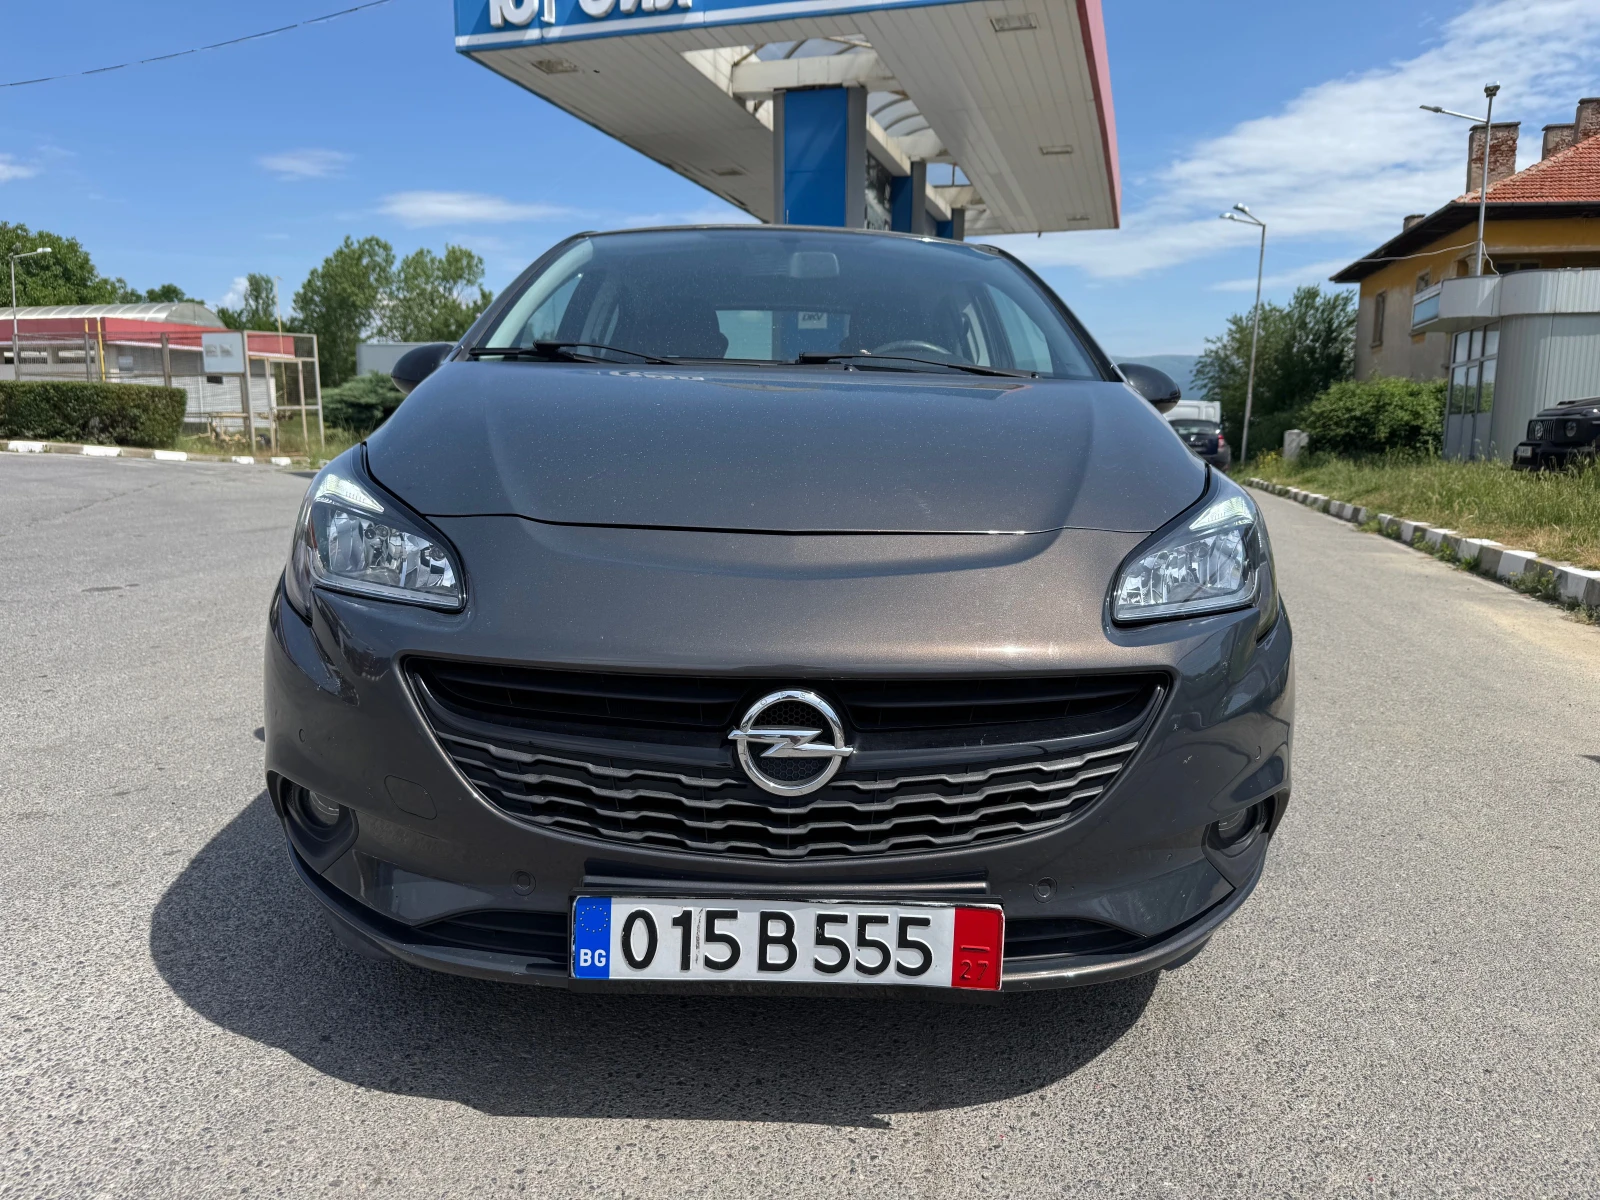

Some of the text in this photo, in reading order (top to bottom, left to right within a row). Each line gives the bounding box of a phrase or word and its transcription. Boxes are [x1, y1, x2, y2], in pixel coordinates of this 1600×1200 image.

[760, 692, 823, 708] OPEL
[813, 913, 933, 977] 555
[579, 948, 607, 967] BG
[959, 959, 989, 981] 27
